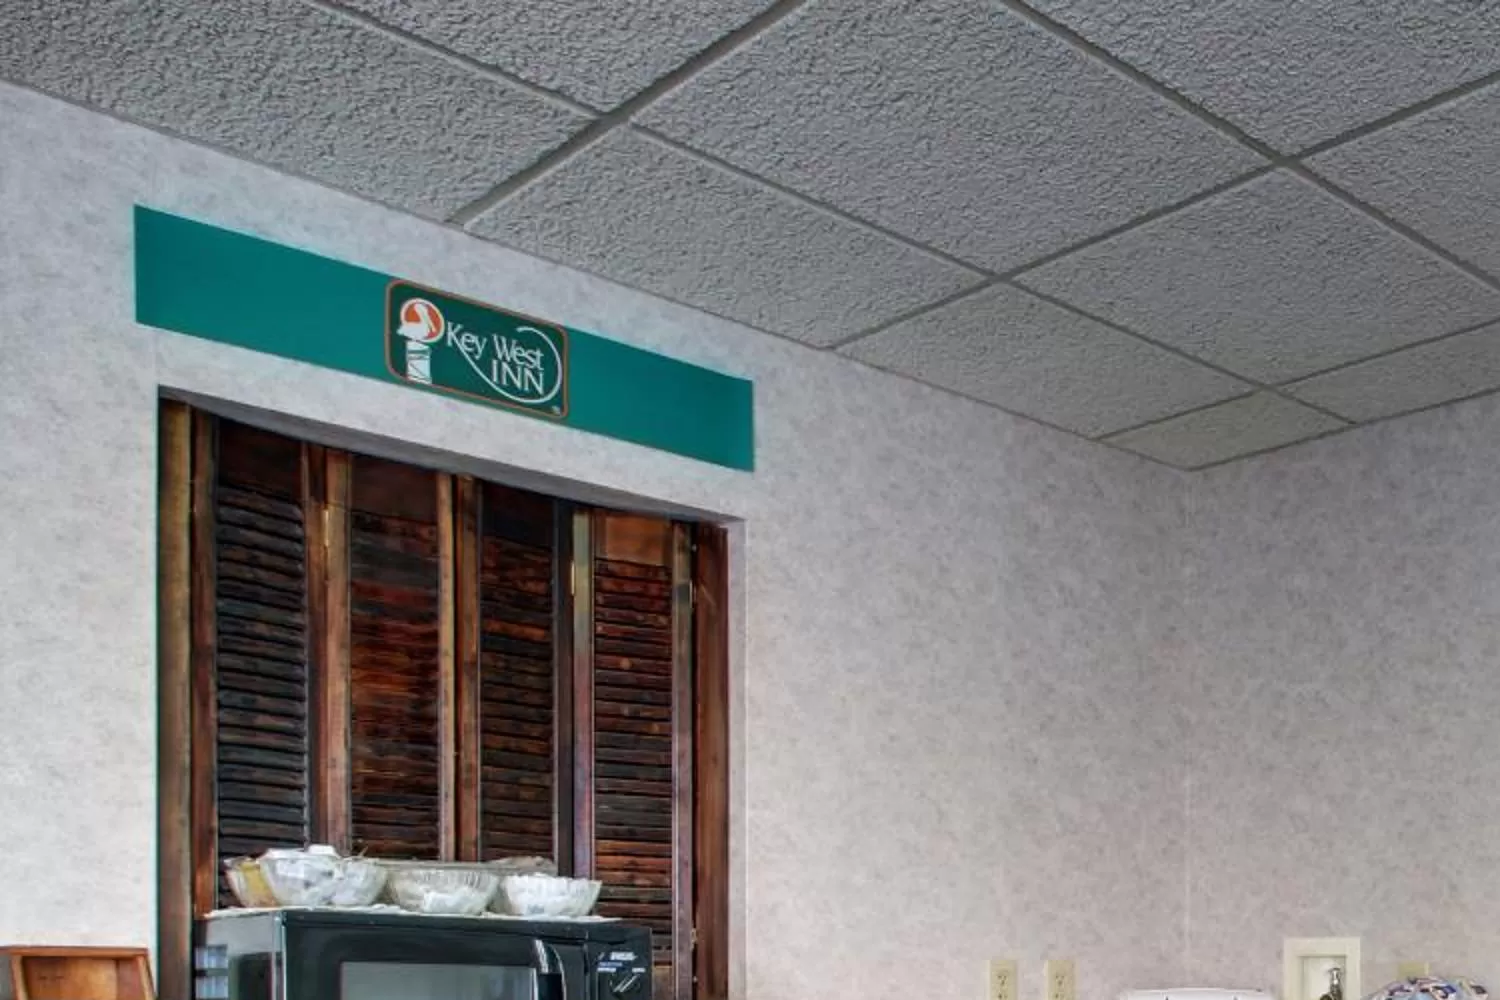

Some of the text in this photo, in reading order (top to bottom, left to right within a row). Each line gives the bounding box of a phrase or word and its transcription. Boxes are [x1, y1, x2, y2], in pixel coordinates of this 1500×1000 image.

[447, 321, 544, 371] Key West
[492, 359, 544, 395] INN
